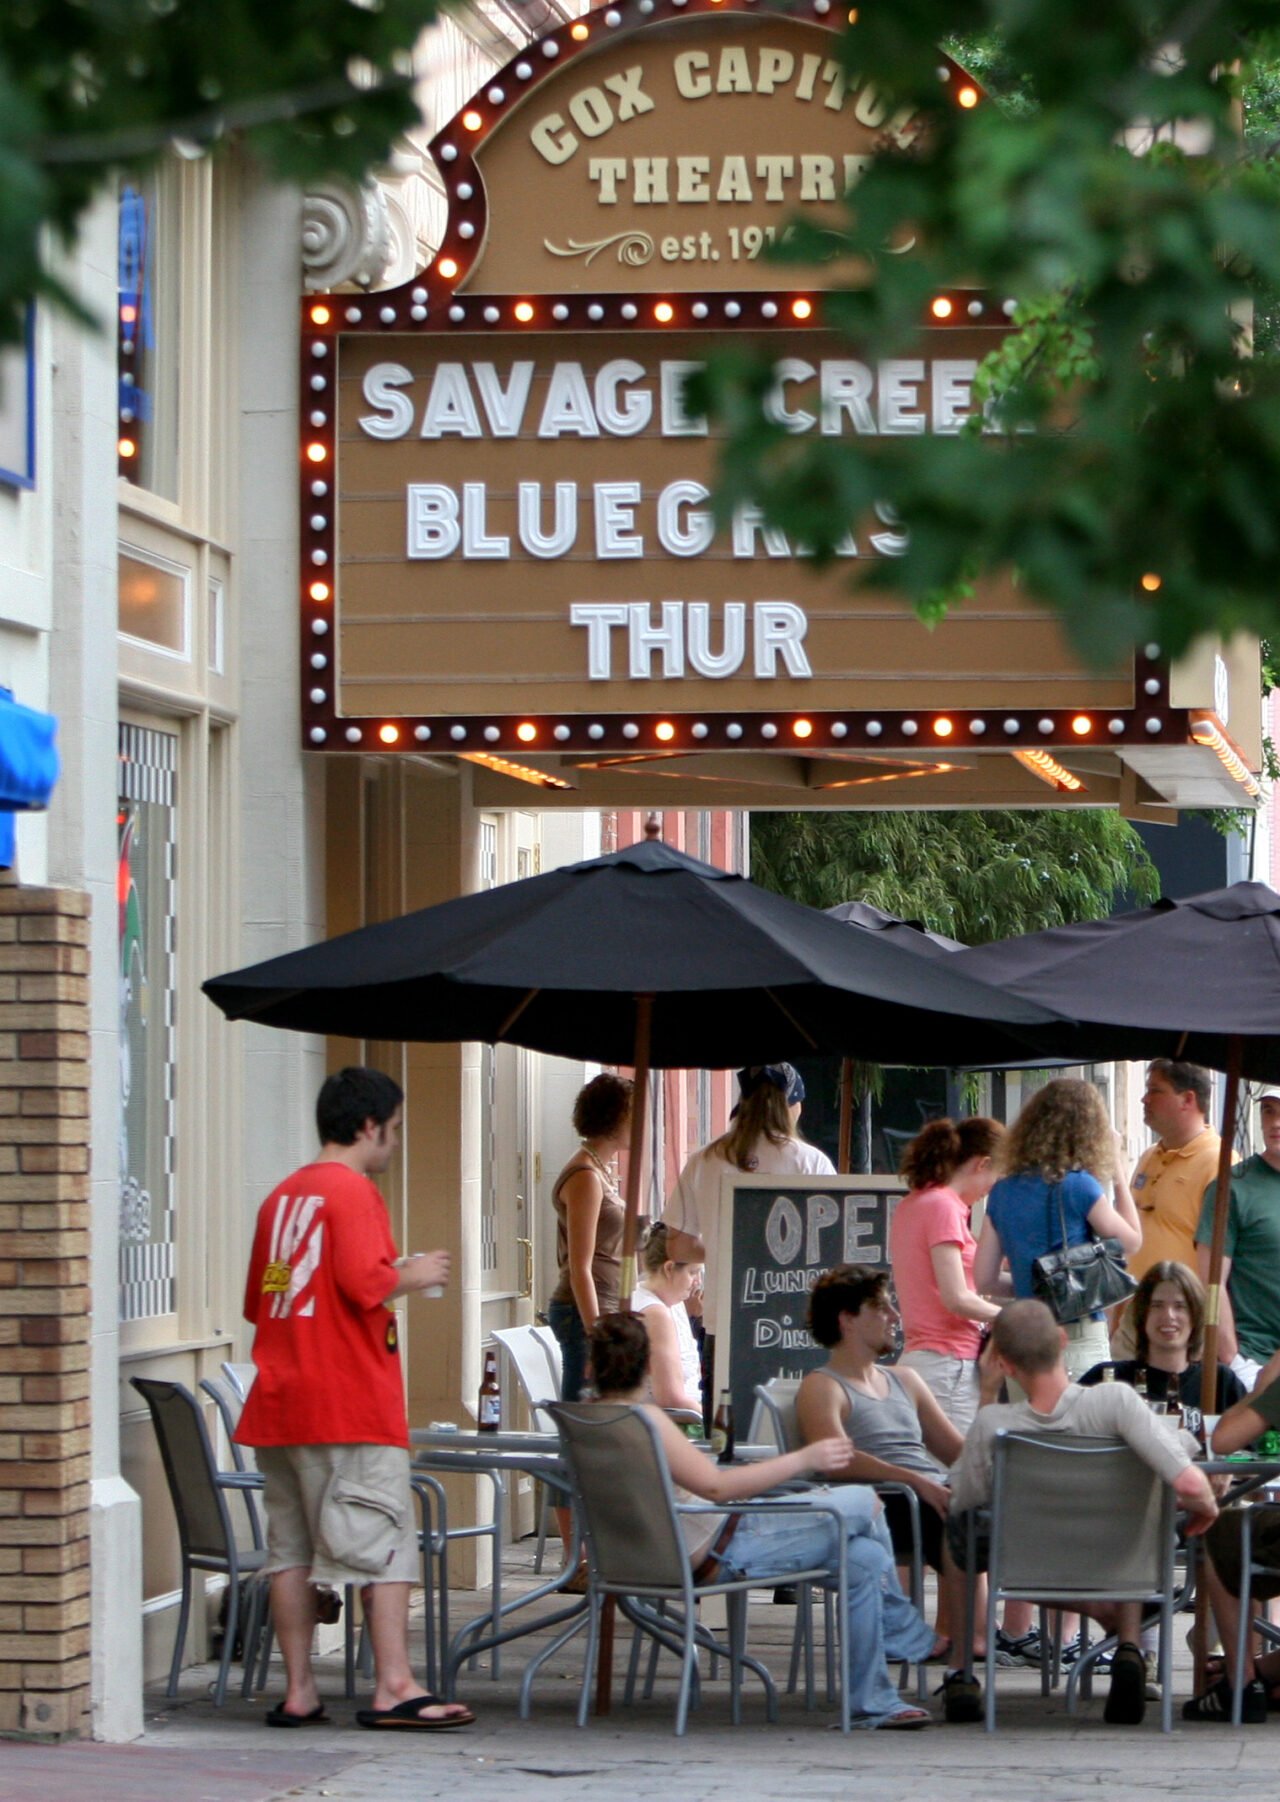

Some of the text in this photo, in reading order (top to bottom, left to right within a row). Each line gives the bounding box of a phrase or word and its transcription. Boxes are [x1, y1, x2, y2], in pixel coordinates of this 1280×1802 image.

[530, 65, 656, 166] COX
[660, 229, 719, 261] est.
[358, 358, 709, 440] SAVAGE
[569, 601, 813, 680] THUR
[743, 1267, 832, 1303] LUNC
